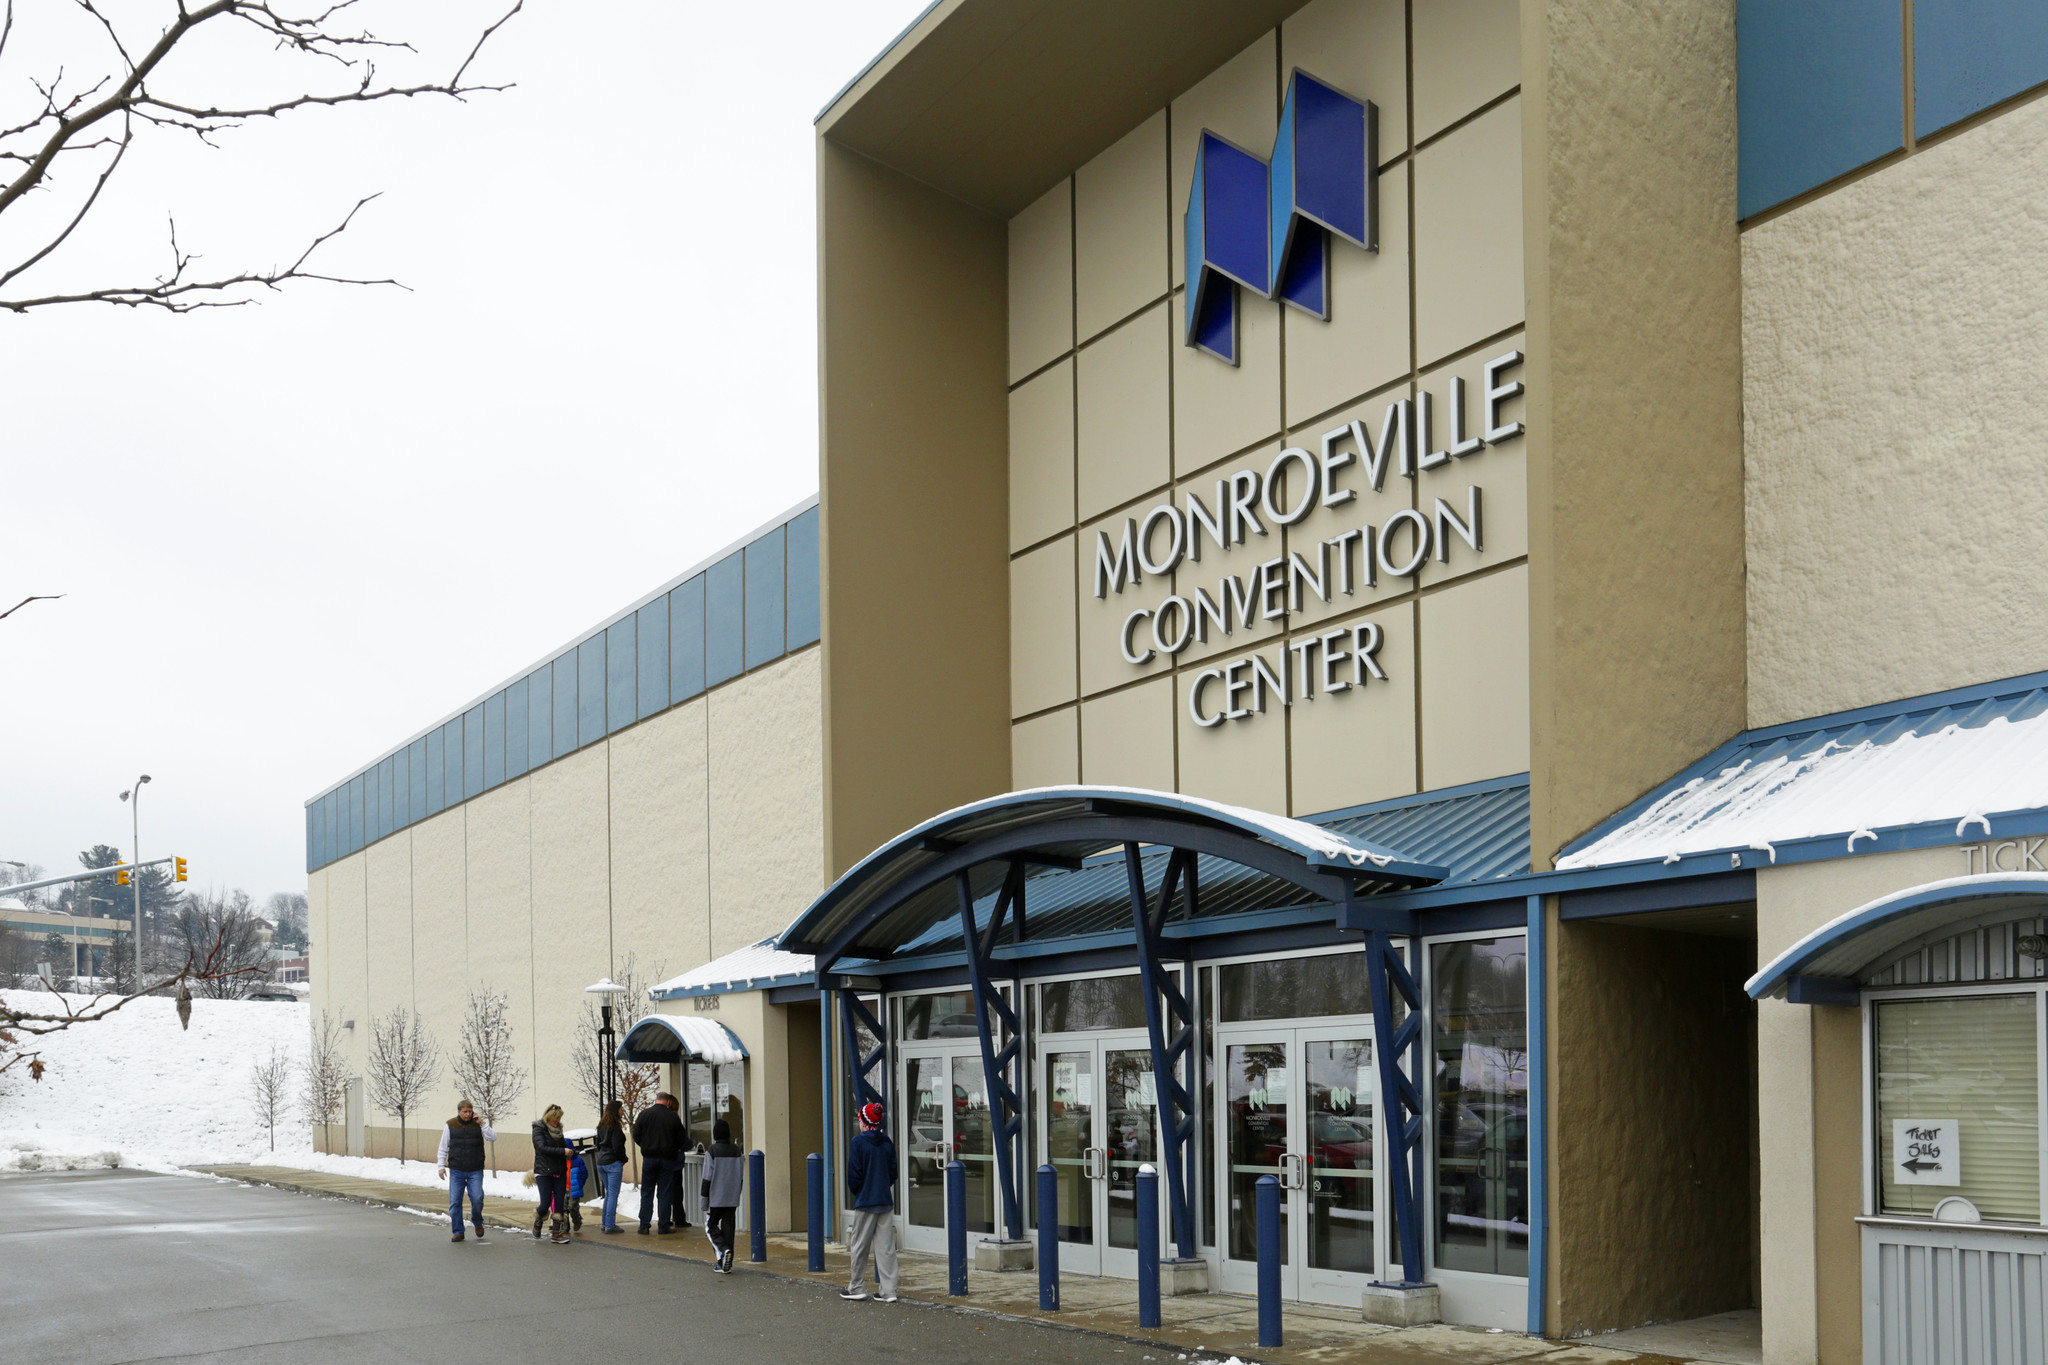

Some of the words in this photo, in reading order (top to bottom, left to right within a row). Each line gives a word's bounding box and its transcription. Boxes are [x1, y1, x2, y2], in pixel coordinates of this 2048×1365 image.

[1093, 350, 1525, 598] MONROEVILLE
[1120, 485, 1483, 664] CONVENTION
[1189, 621, 1389, 727] CENTER
